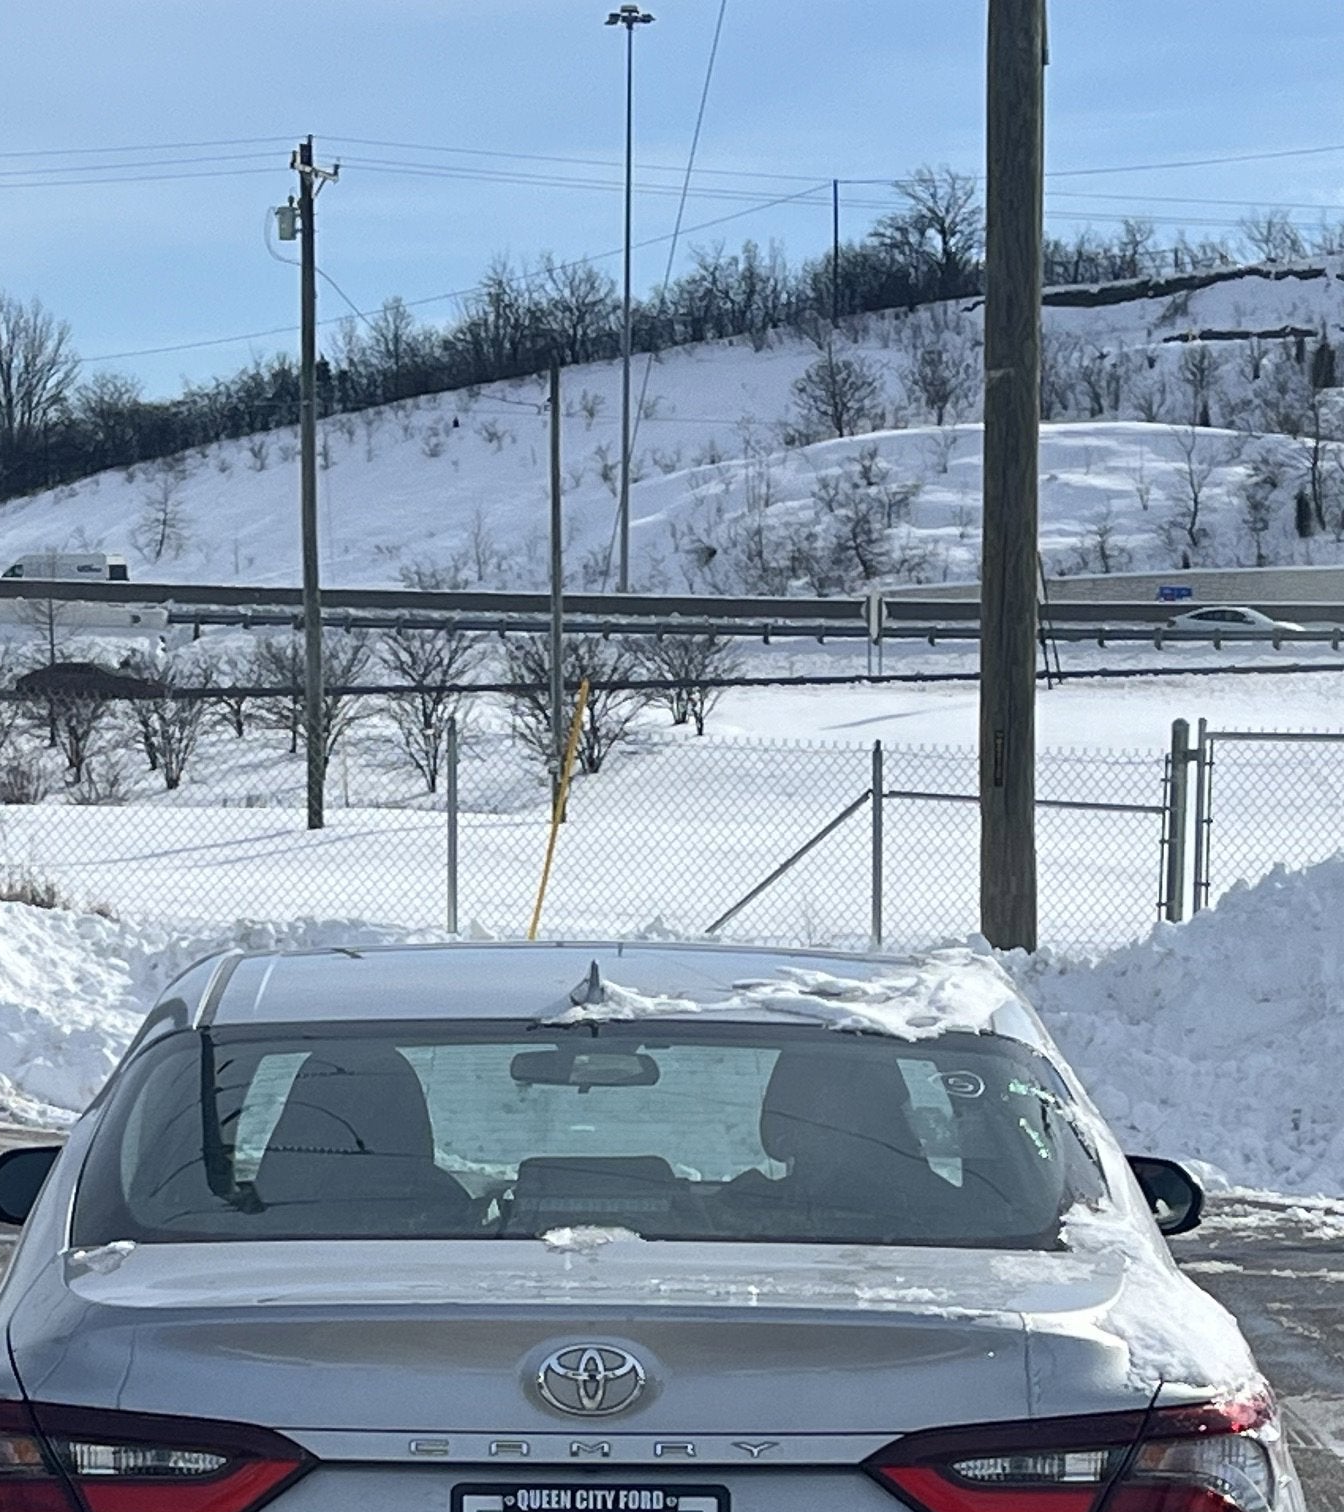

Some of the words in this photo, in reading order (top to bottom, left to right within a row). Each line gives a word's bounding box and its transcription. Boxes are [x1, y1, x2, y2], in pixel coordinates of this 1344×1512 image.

[408, 1439, 780, 1458] CAMRY
[516, 1489, 572, 1511] QUEEN
[575, 1489, 616, 1510] CITY
[619, 1489, 664, 1510] FORD
